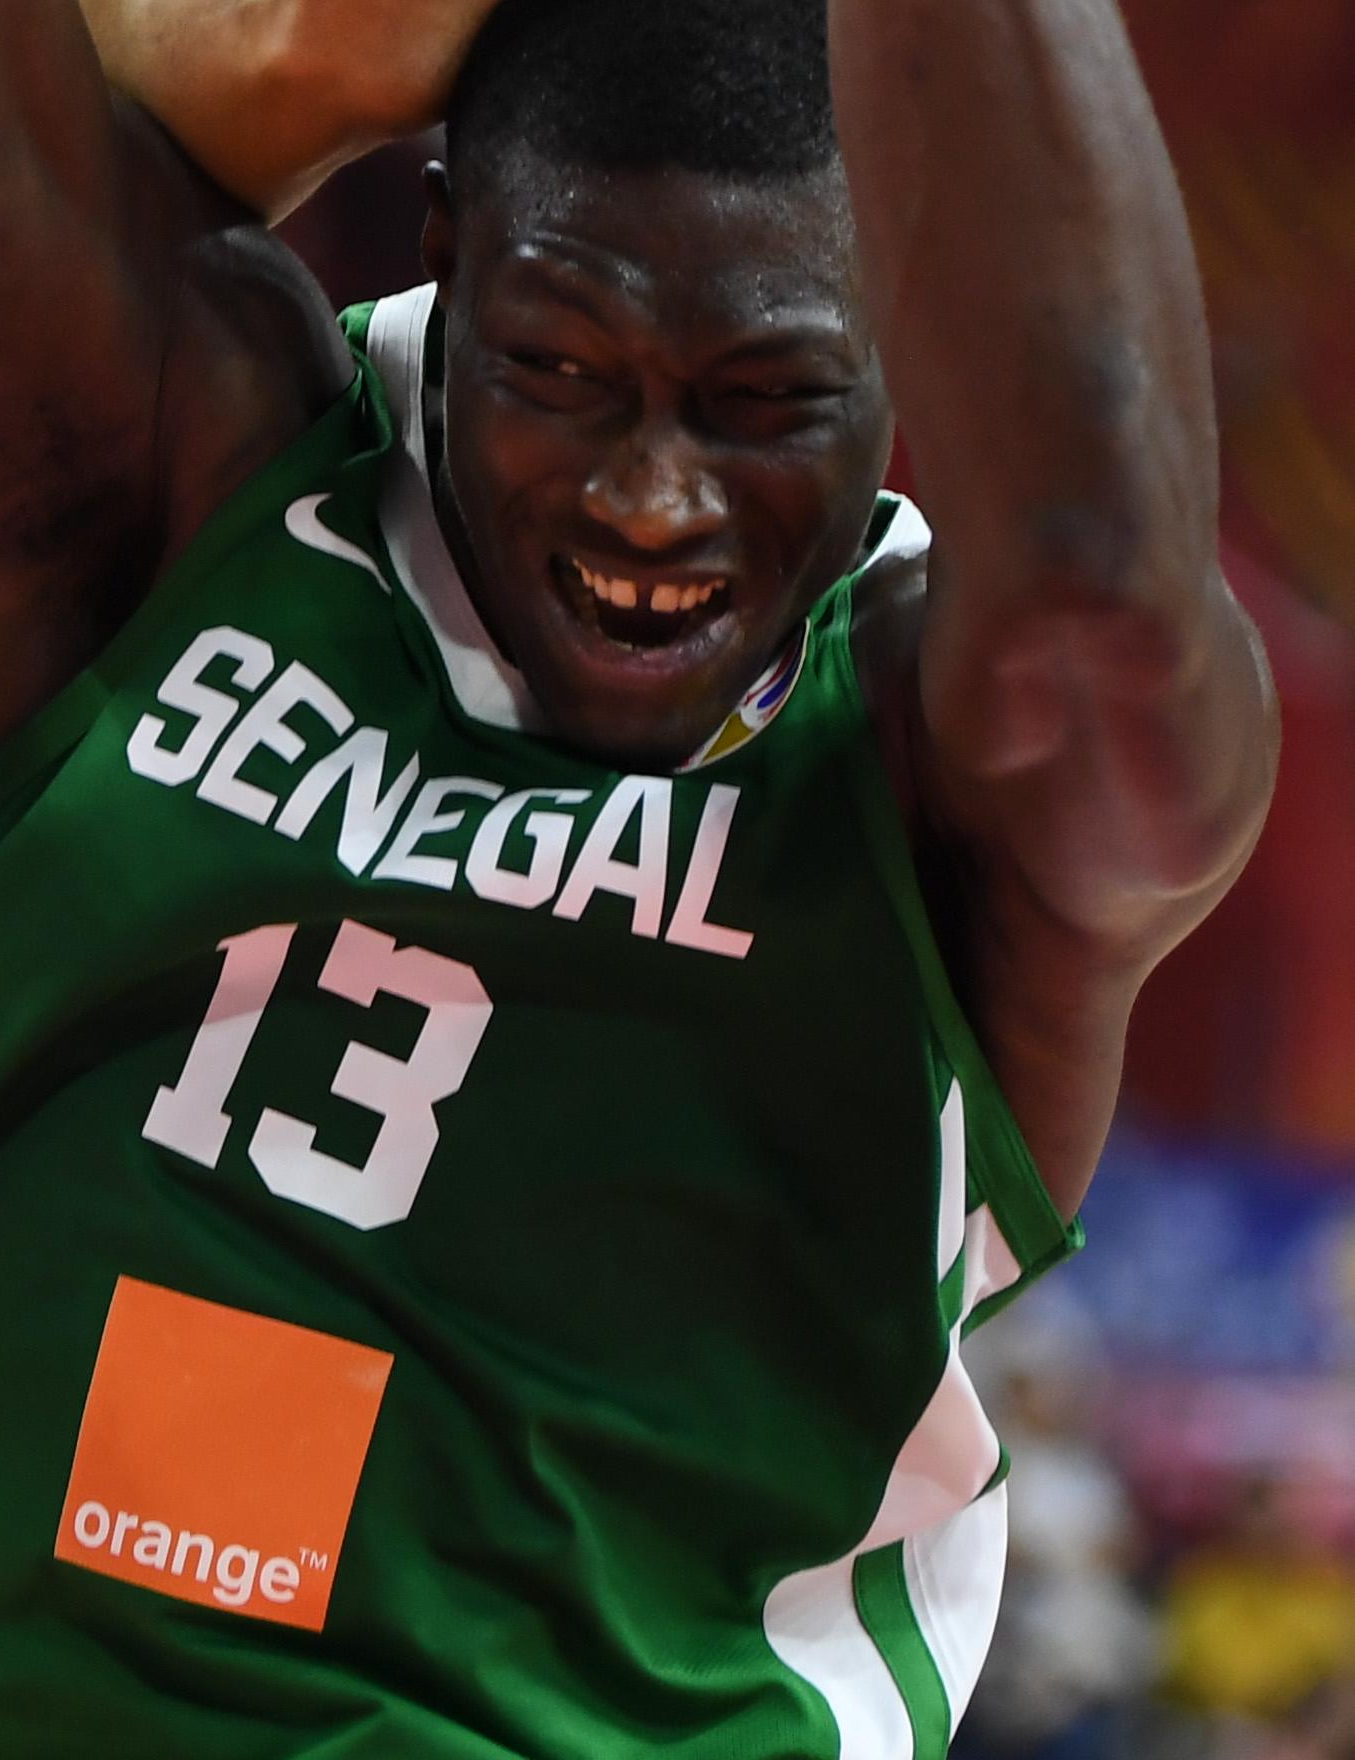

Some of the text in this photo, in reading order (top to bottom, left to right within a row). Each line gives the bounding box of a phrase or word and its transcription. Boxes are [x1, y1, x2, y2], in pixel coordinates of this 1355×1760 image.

[126, 624, 754, 960] SENEGAL
[141, 918, 494, 1231] 13
[73, 1500, 301, 1607] orange
